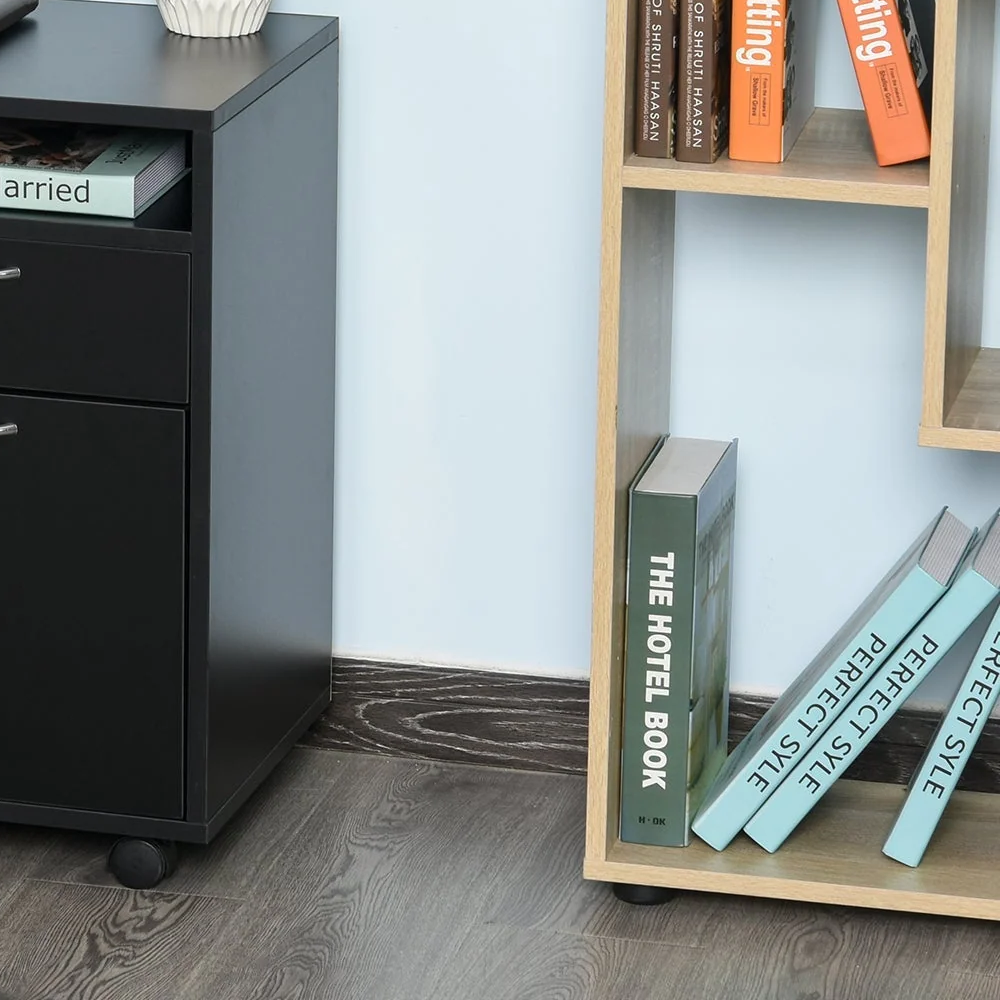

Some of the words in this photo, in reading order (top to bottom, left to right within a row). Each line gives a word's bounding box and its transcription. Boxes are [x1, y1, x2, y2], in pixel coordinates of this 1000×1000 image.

[694, 3, 704, 23] OF
[651, 24, 661, 73] SHRUTI
[694, 30, 704, 80] SHRUTI
[649, 79, 660, 141] HAASAN
[692, 87, 703, 148] HAASAN
[648, 552, 675, 607] THE
[645, 614, 673, 703] HOTEL
[797, 632, 887, 738] PERFECT
[849, 633, 939, 739] PERFECT
[956, 631, 1000, 734] RFECT
[641, 711, 669, 790] BOOK
[747, 734, 800, 793] SYLE
[798, 735, 852, 794] SYLE
[922, 734, 966, 799] SYLE
